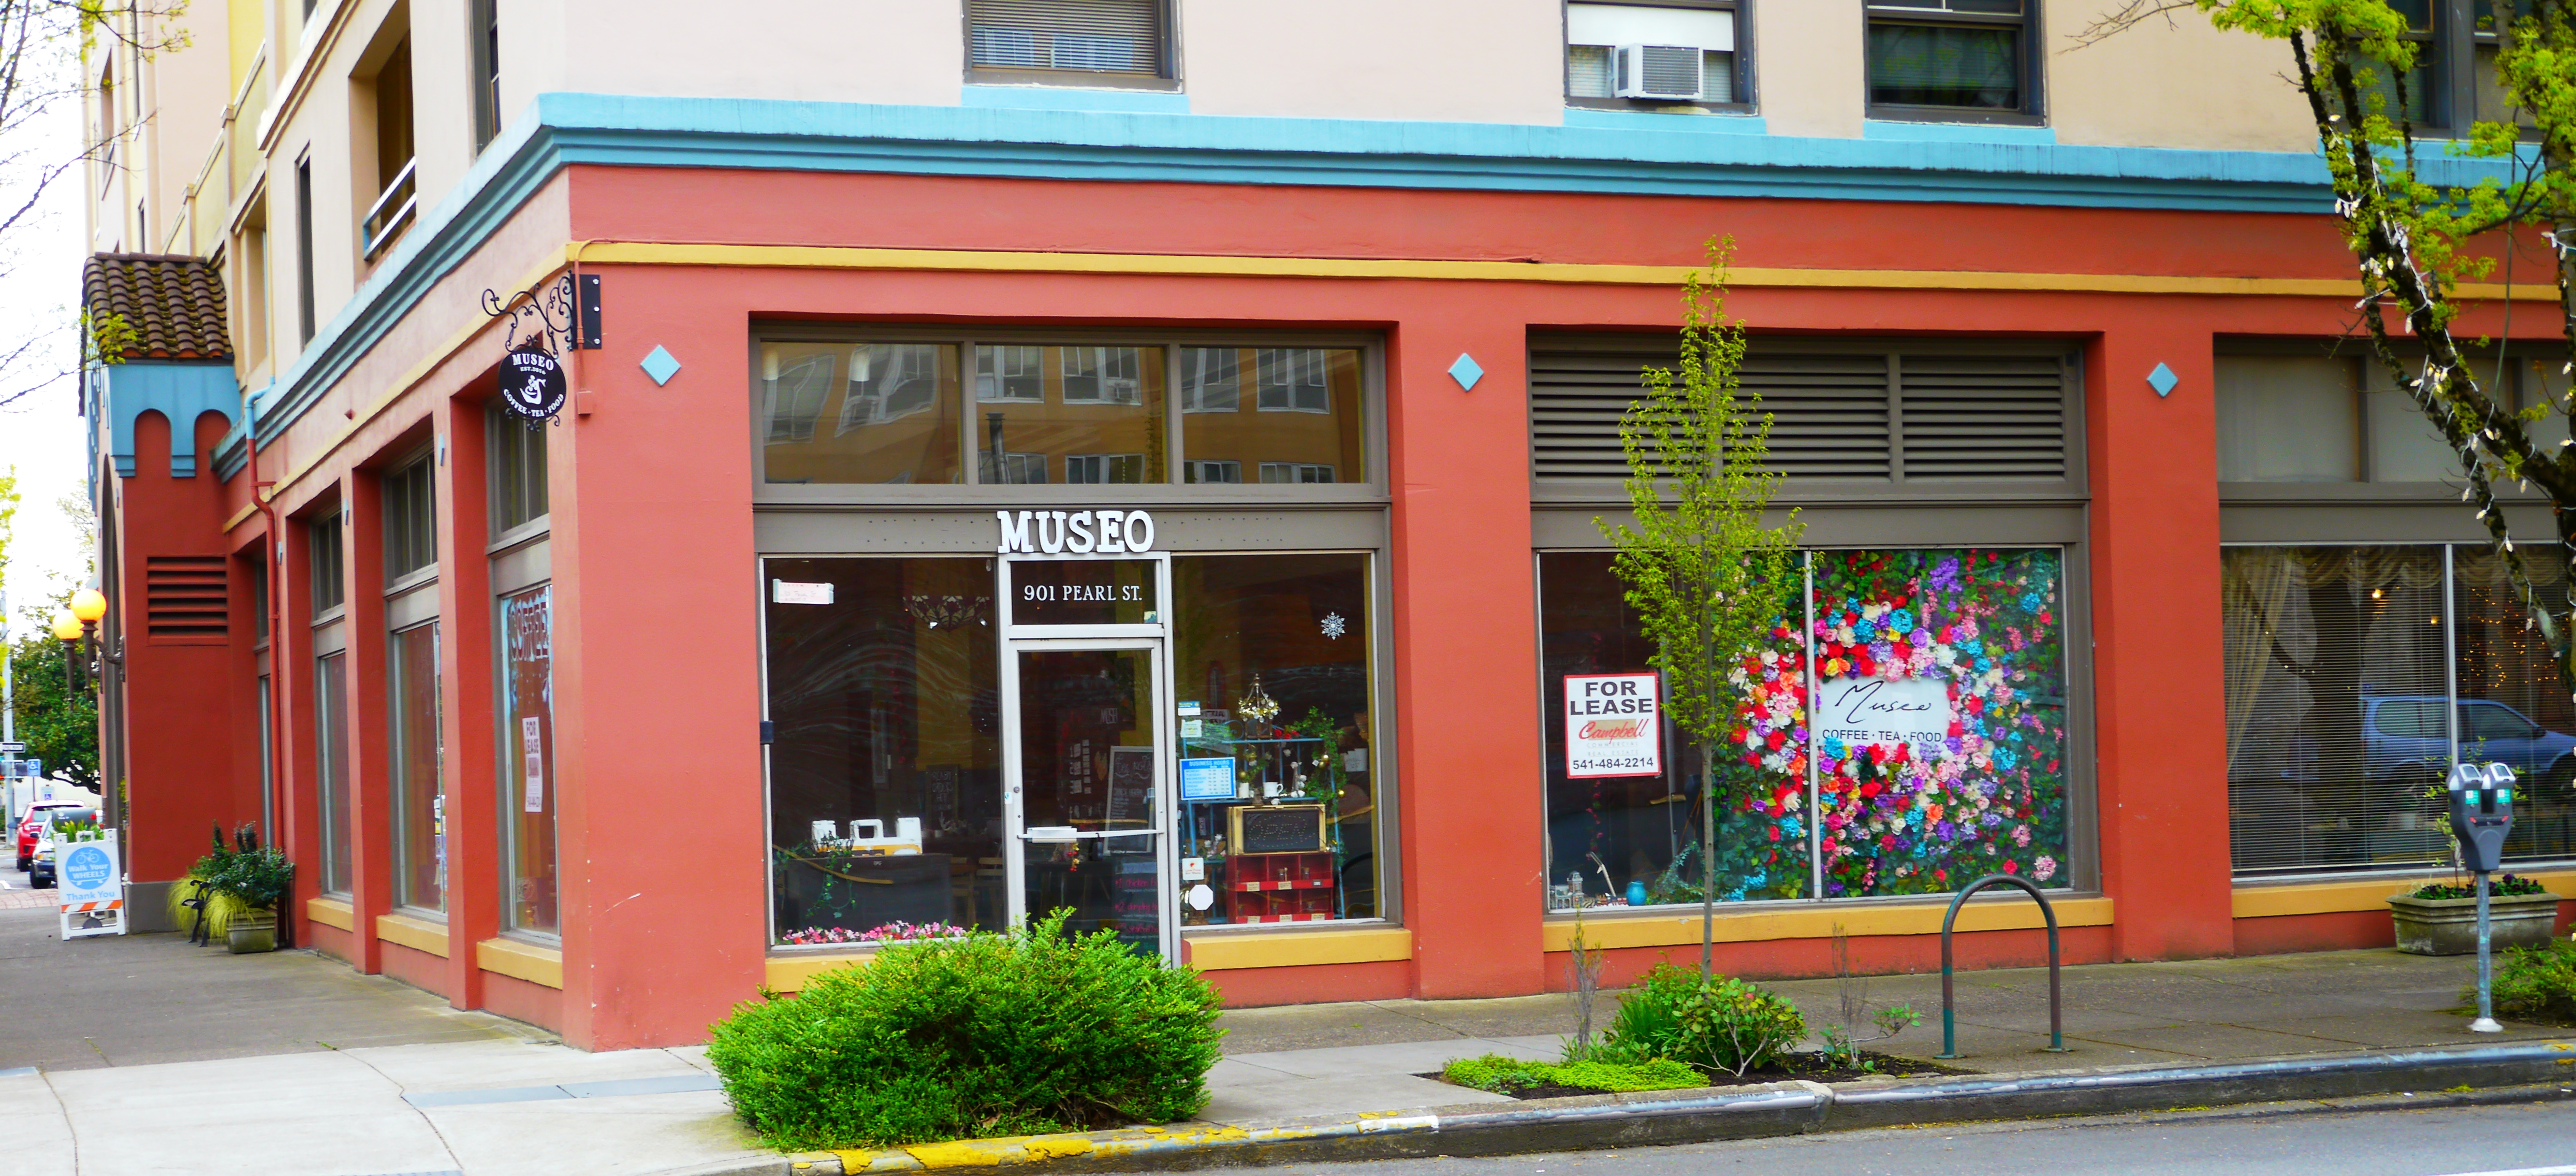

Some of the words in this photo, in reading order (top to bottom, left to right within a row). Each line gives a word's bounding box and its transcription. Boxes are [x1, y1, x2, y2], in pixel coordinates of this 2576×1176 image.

[512, 353, 554, 371] MUSEO
[503, 388, 528, 414] COFFEE
[547, 394, 564, 413] FOOD
[997, 511, 1154, 554] MUSEO
[1024, 585, 1055, 601] 901
[1062, 585, 1117, 601] PEARL
[1122, 585, 1143, 601] ST.
[1585, 681, 1637, 697] FOR
[1570, 699, 1653, 716] LEASE
[1835, 680, 1931, 723] Museo
[1578, 718, 1649, 744] Campbell
[1822, 729, 1868, 740] COFFEE
[1878, 731, 1900, 741] TEA
[1910, 732, 1942, 742] FOOD
[1573, 757, 1653, 770] 541-484-2214
[72, 870, 105, 879] WHEELS
[66, 892, 96, 901] Thank
